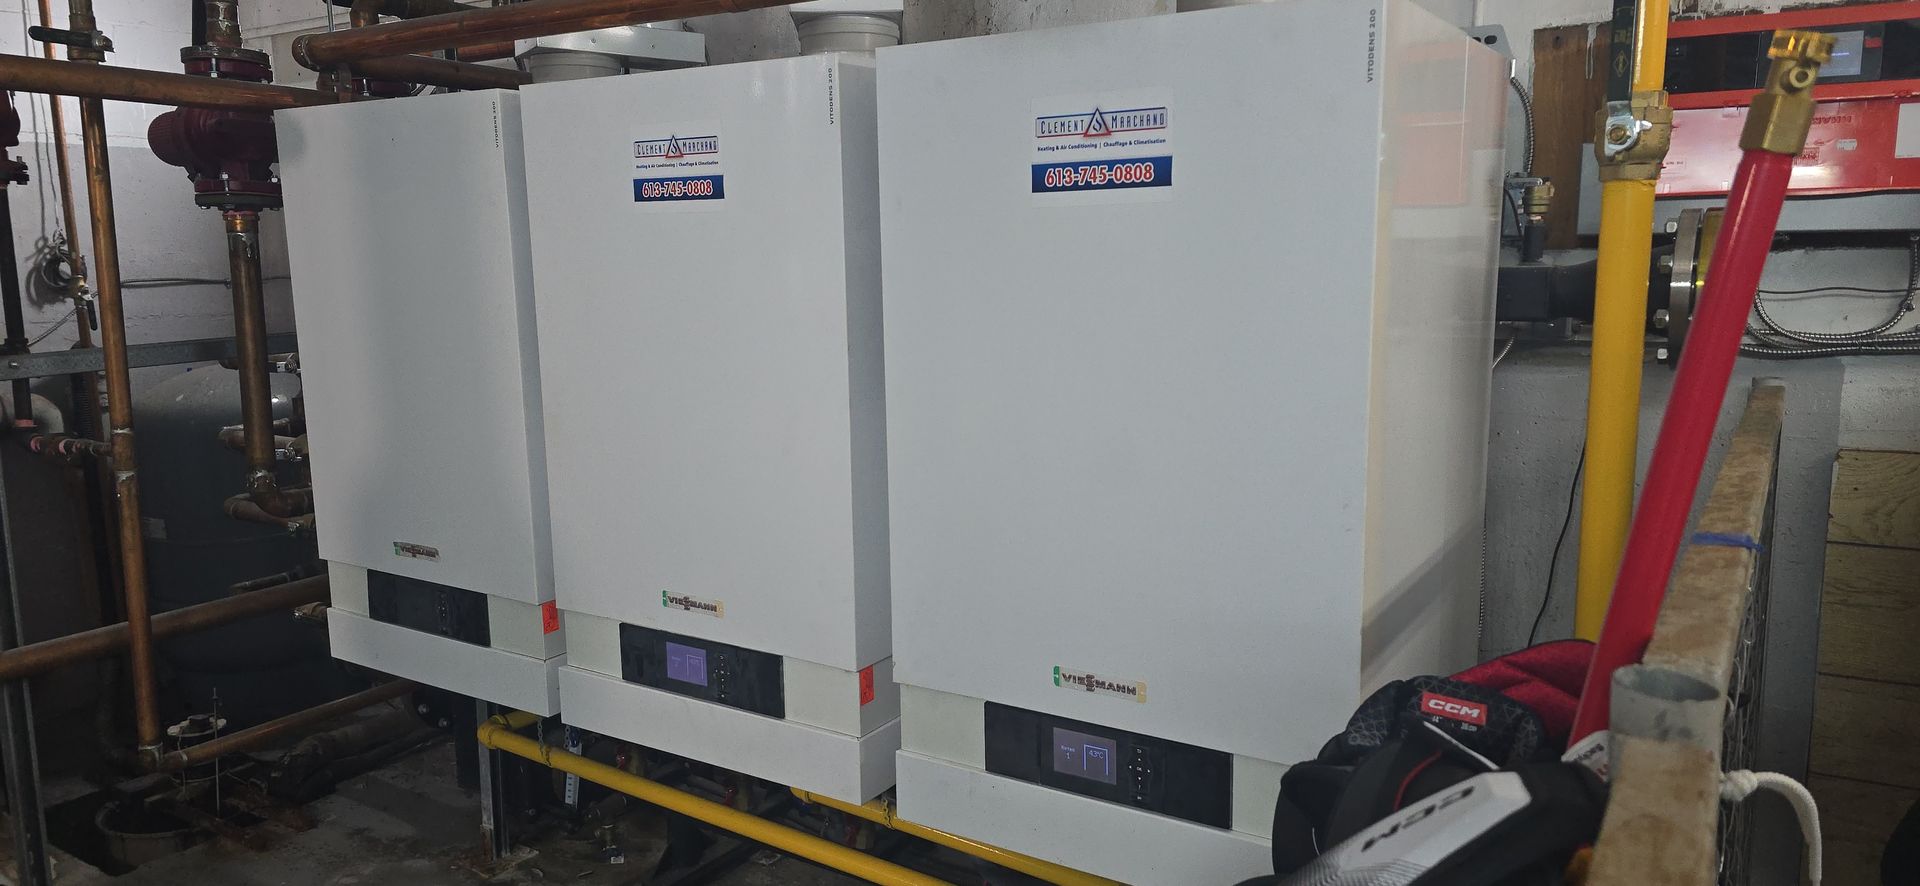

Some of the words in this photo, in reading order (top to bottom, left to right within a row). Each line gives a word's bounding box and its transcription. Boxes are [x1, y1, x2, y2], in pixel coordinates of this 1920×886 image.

[1367, 31, 1375, 83] VITODENS
[1040, 119, 1085, 134] CLEMENT
[1111, 112, 1165, 129] MARCHAND
[637, 143, 666, 156] CLEMENT
[1103, 140, 1128, 148] Chauffage
[1045, 162, 1154, 188] 613-745-0808
[642, 179, 714, 198] 613-745-0808
[1428, 698, 1481, 718] CCM
[1361, 785, 1475, 853] CCM
